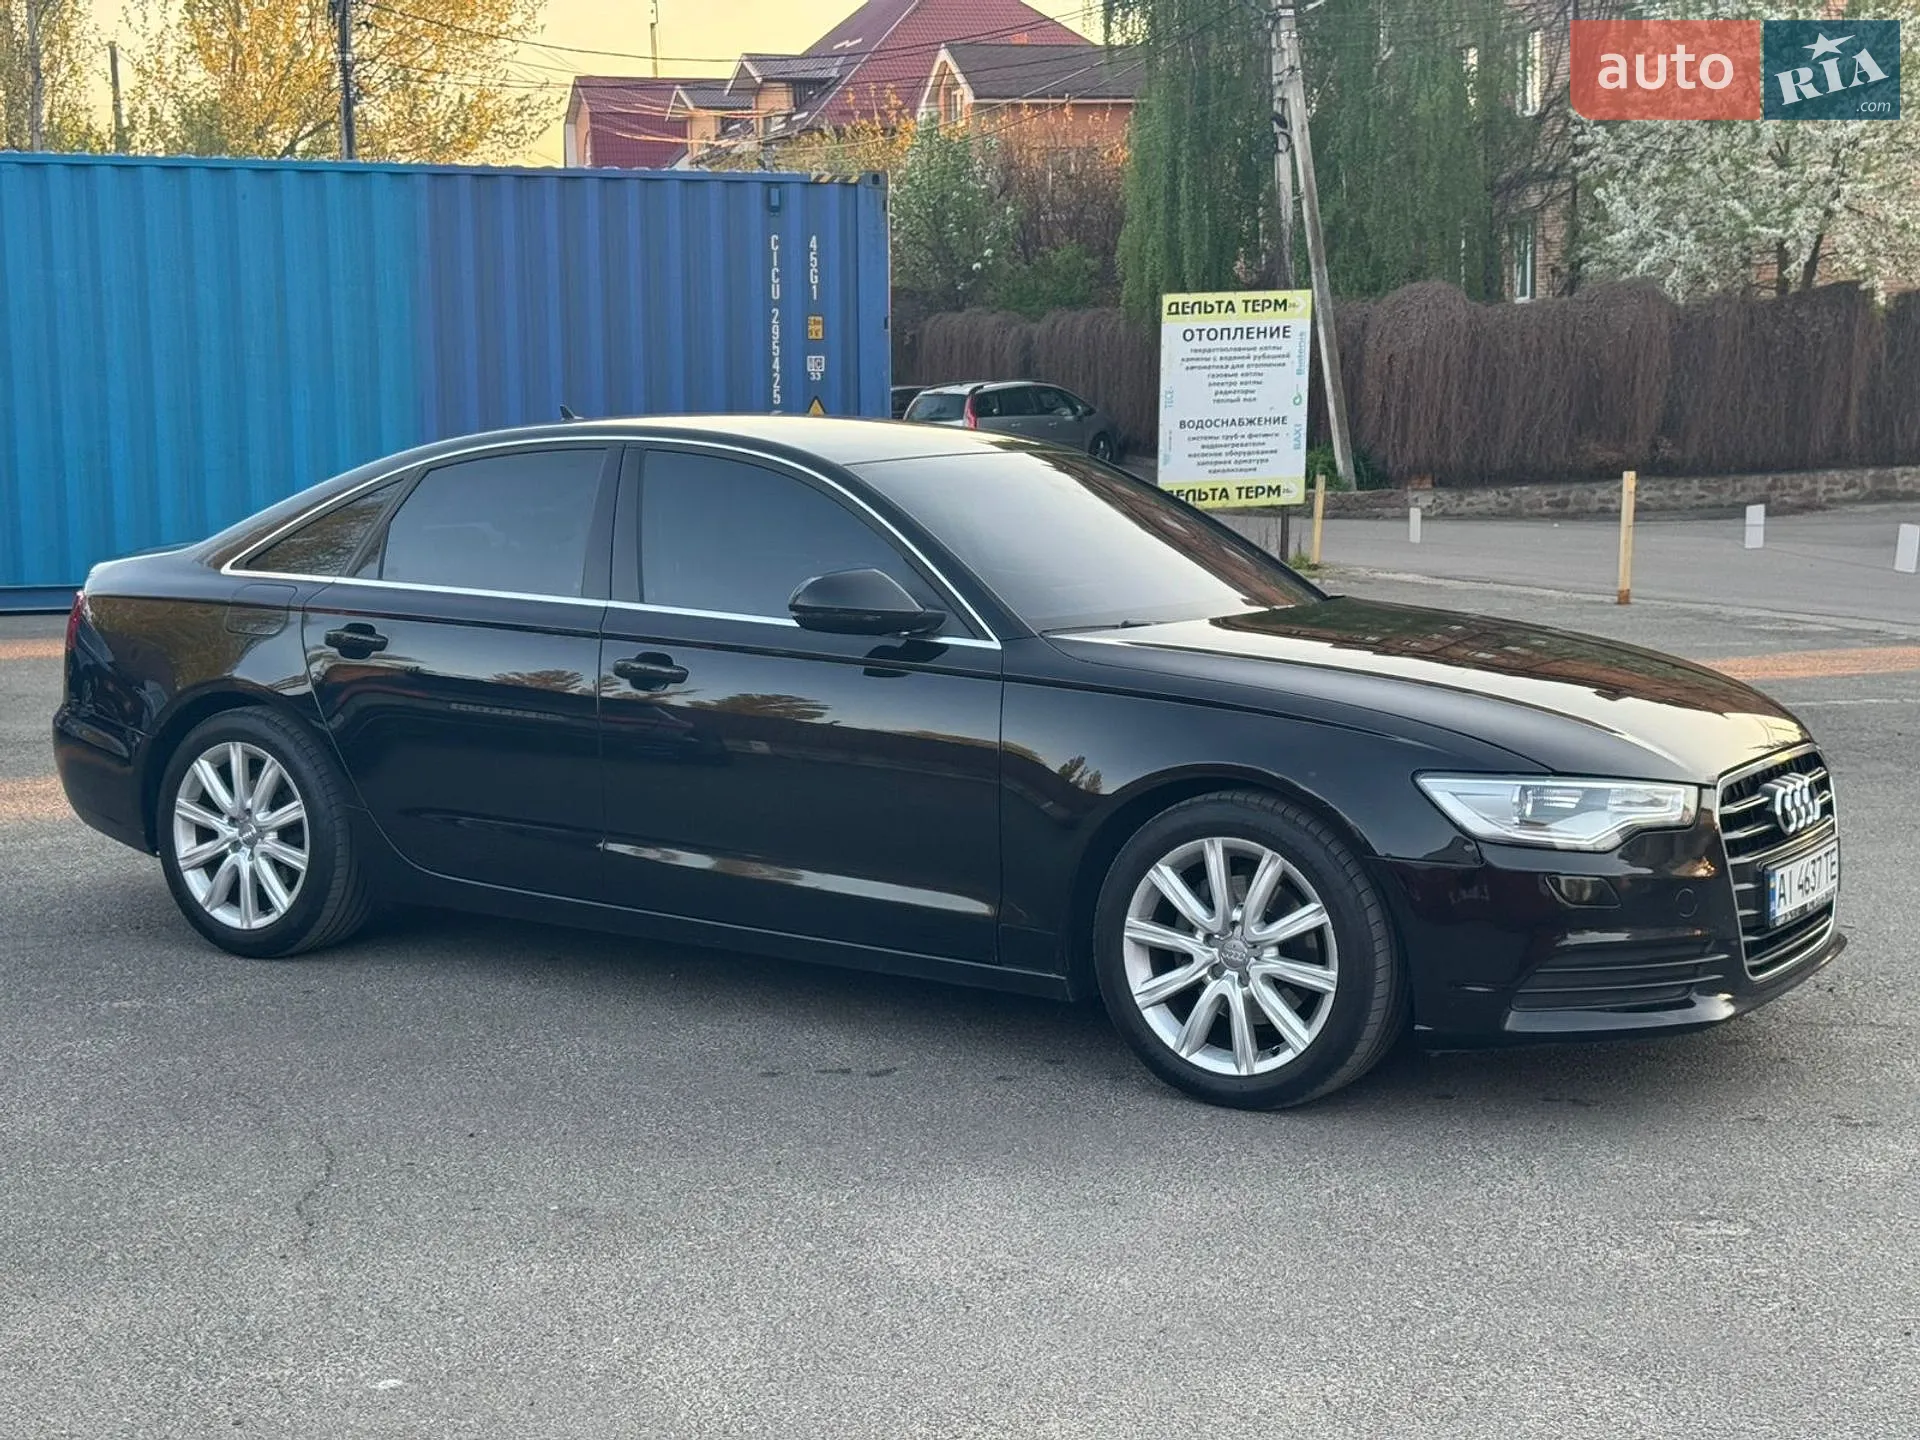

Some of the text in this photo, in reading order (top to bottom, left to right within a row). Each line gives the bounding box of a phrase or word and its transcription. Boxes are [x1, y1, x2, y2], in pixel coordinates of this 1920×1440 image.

[808, 235, 819, 301] 45G1
[1167, 301, 1236, 315] ДЕЛЬТА
[1242, 299, 1288, 312] ТЕРМ
[770, 234, 782, 405] CICU 295425
[1182, 325, 1292, 342] ОТОПЛЕНИЕ
[1179, 415, 1288, 430] ВОДОСНАБЖЕНИЕ
[1236, 484, 1281, 499] ТЕРМ
[1777, 870, 1793, 908] AI
[1797, 856, 1823, 897] 4637
[1824, 847, 1837, 884] TE
